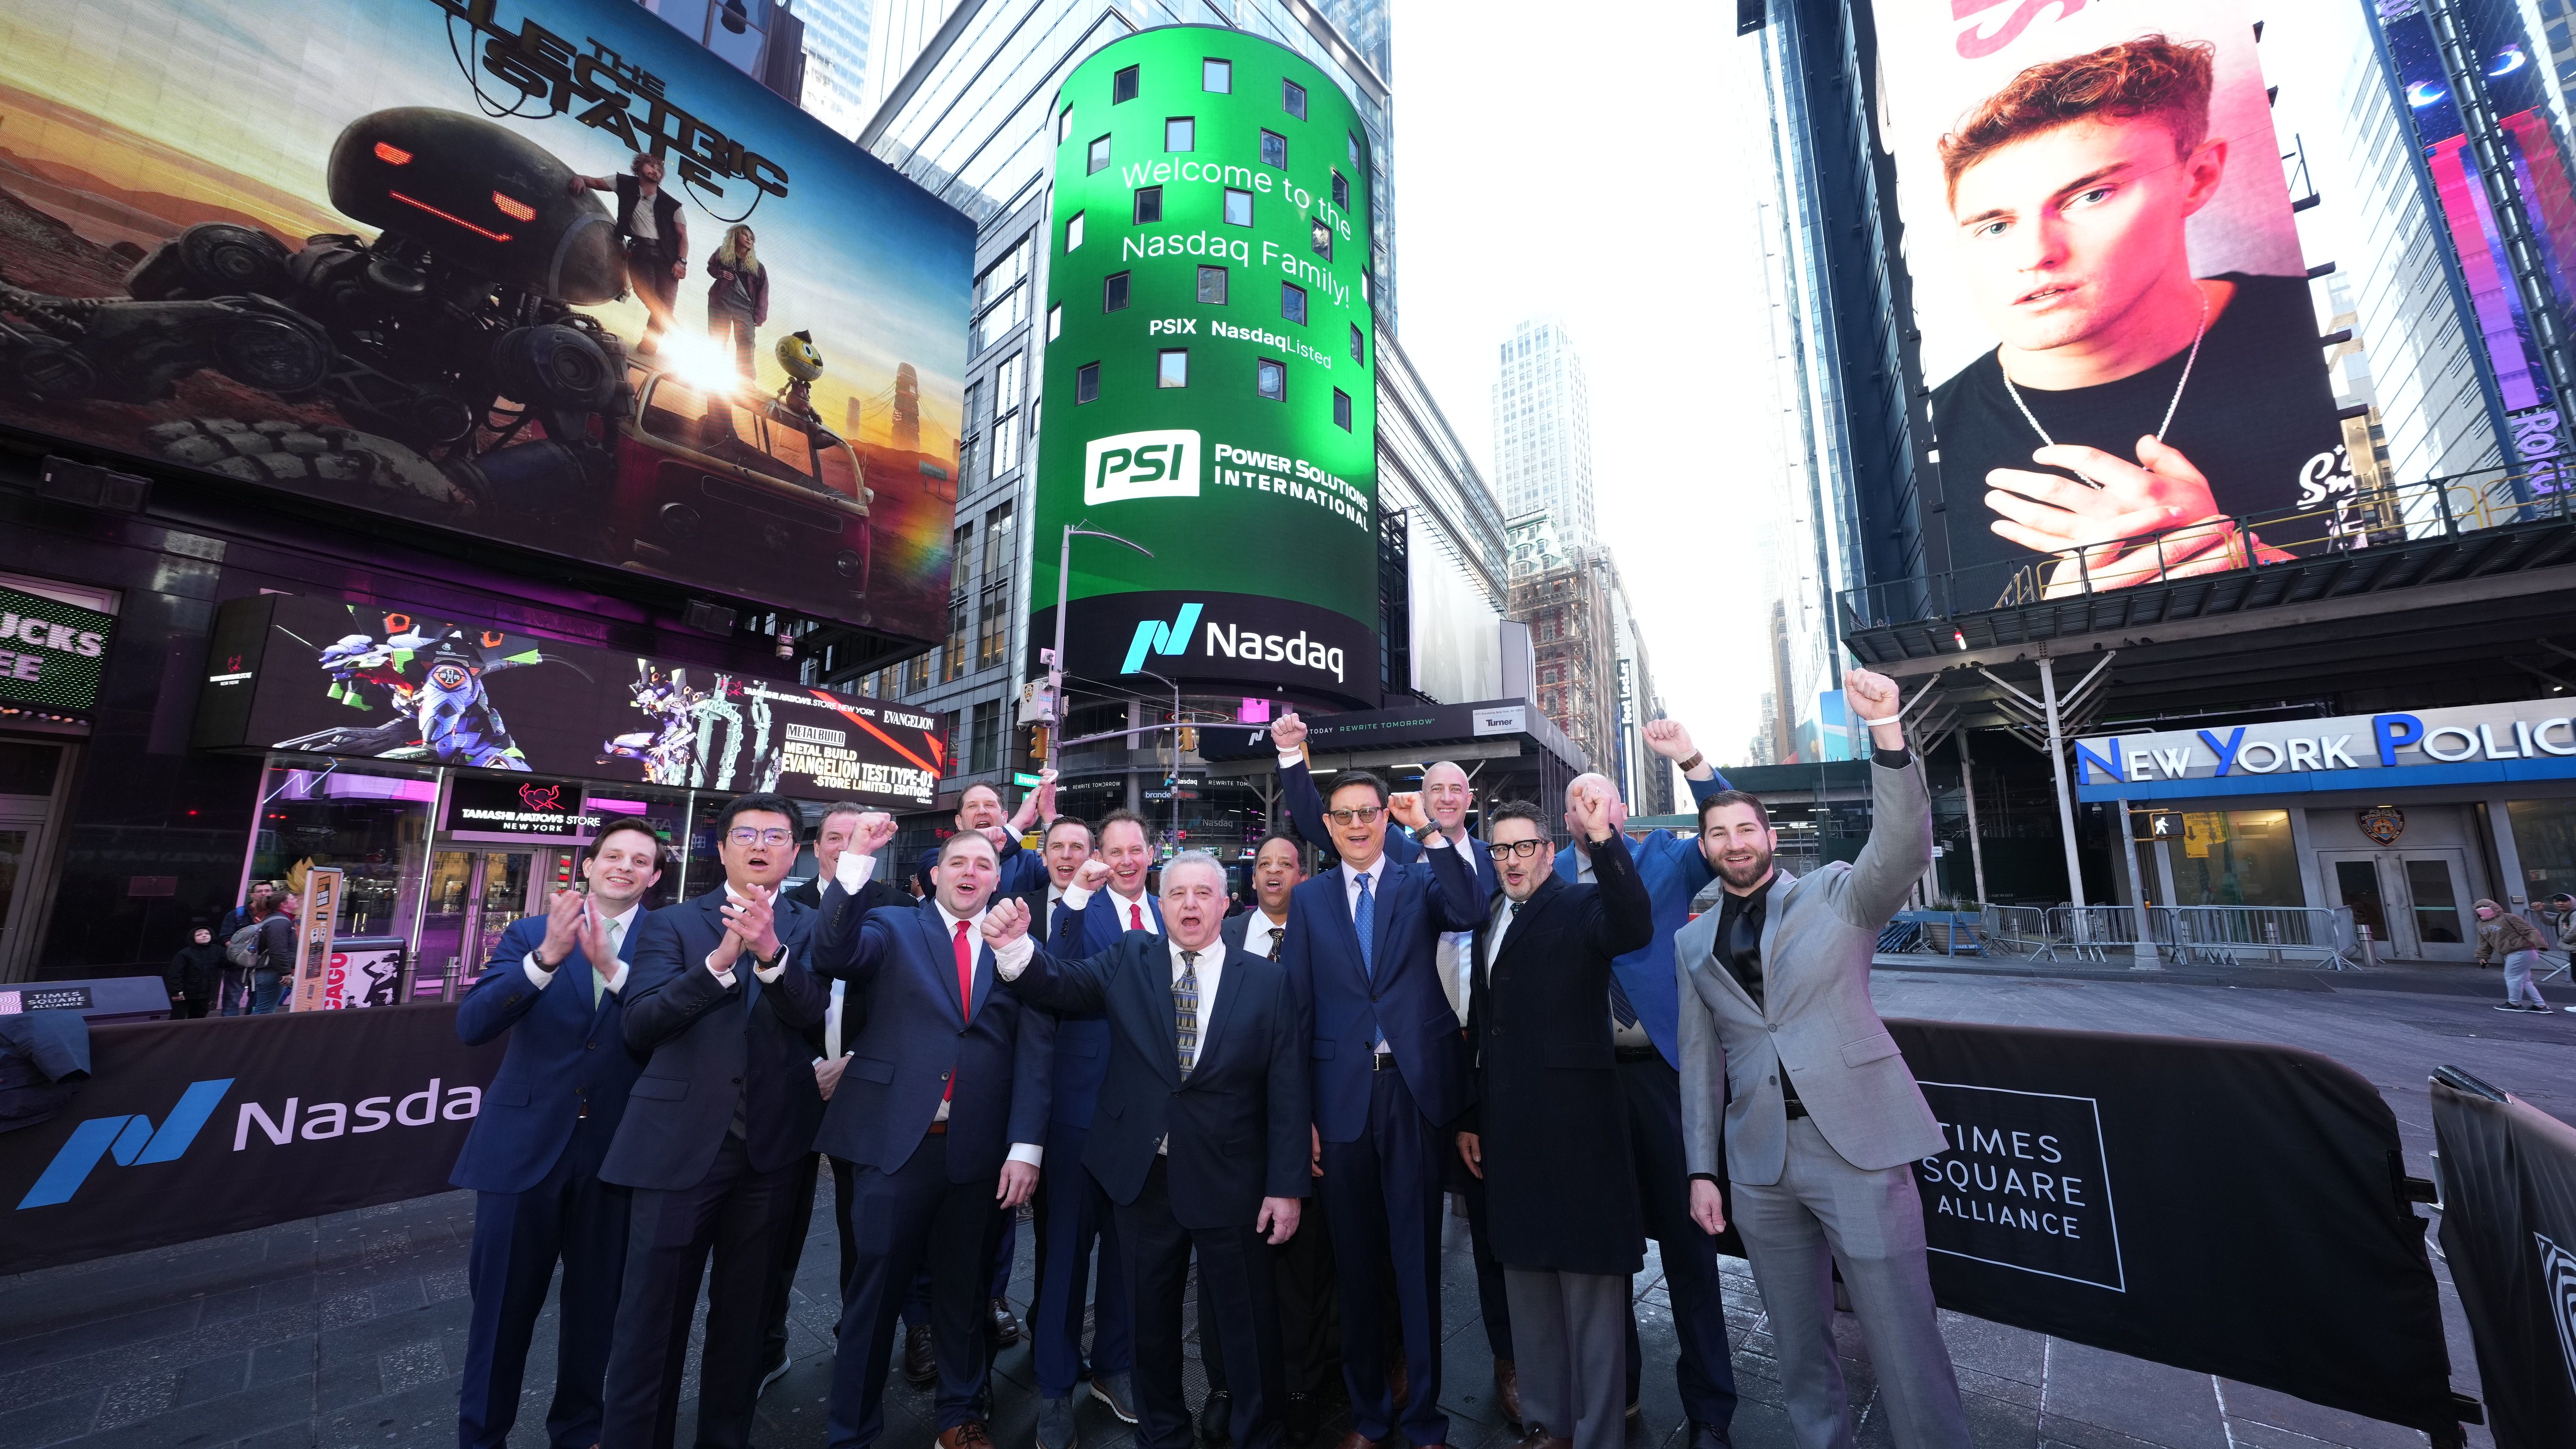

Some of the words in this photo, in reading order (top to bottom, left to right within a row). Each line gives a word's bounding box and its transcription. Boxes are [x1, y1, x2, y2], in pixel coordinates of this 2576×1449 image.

[586, 36, 666, 98] THE
[483, 39, 723, 198] STATE
[1122, 157, 1271, 194] Welcome
[1282, 178, 1310, 209] to
[1318, 199, 1351, 241] the
[1122, 230, 1249, 268] Nasdaq
[1262, 241, 1350, 308] Family!
[1149, 318, 1197, 336] PSIX
[1096, 444, 1184, 489] PSI
[1215, 444, 1291, 475] POWER
[1295, 460, 1368, 513] SOLUTIONS
[1215, 466, 1368, 532] INTERNATIONAL
[1207, 622, 1344, 683] Nasdaq
[838, 704, 855, 713] NEW
[855, 707, 875, 716] YORK
[883, 710, 934, 730] EVANGELION
[1621, 700, 1632, 724] Foot
[1340, 724, 1377, 732] REWRITE
[784, 741, 822, 757] METAL
[824, 747, 857, 761] BUILD
[2075, 738, 2192, 785] NEW
[2198, 726, 2359, 776] YORK
[2373, 713, 2576, 767] POLIC
[782, 753, 860, 779] EVANGELION
[862, 763, 889, 782] TEST
[889, 766, 933, 788] TYPE-01
[1018, 774, 1040, 785] Broadwa
[813, 776, 851, 789] -STORE
[853, 780, 892, 793] LIMITED
[894, 784, 933, 797] EDITION-
[516, 813, 564, 823] NATIONS
[566, 816, 600, 827] STORE
[1203, 819, 1233, 828] Nasdaq
[2362, 824, 2371, 833] CITY
[28, 996, 86, 1005] SQUARE
[33, 991, 80, 1000] TIMES
[233, 1078, 482, 1151] Nasda
[1922, 1156, 2085, 1207] SQUARE
[1938, 1195, 2081, 1239] ALLIANCE
